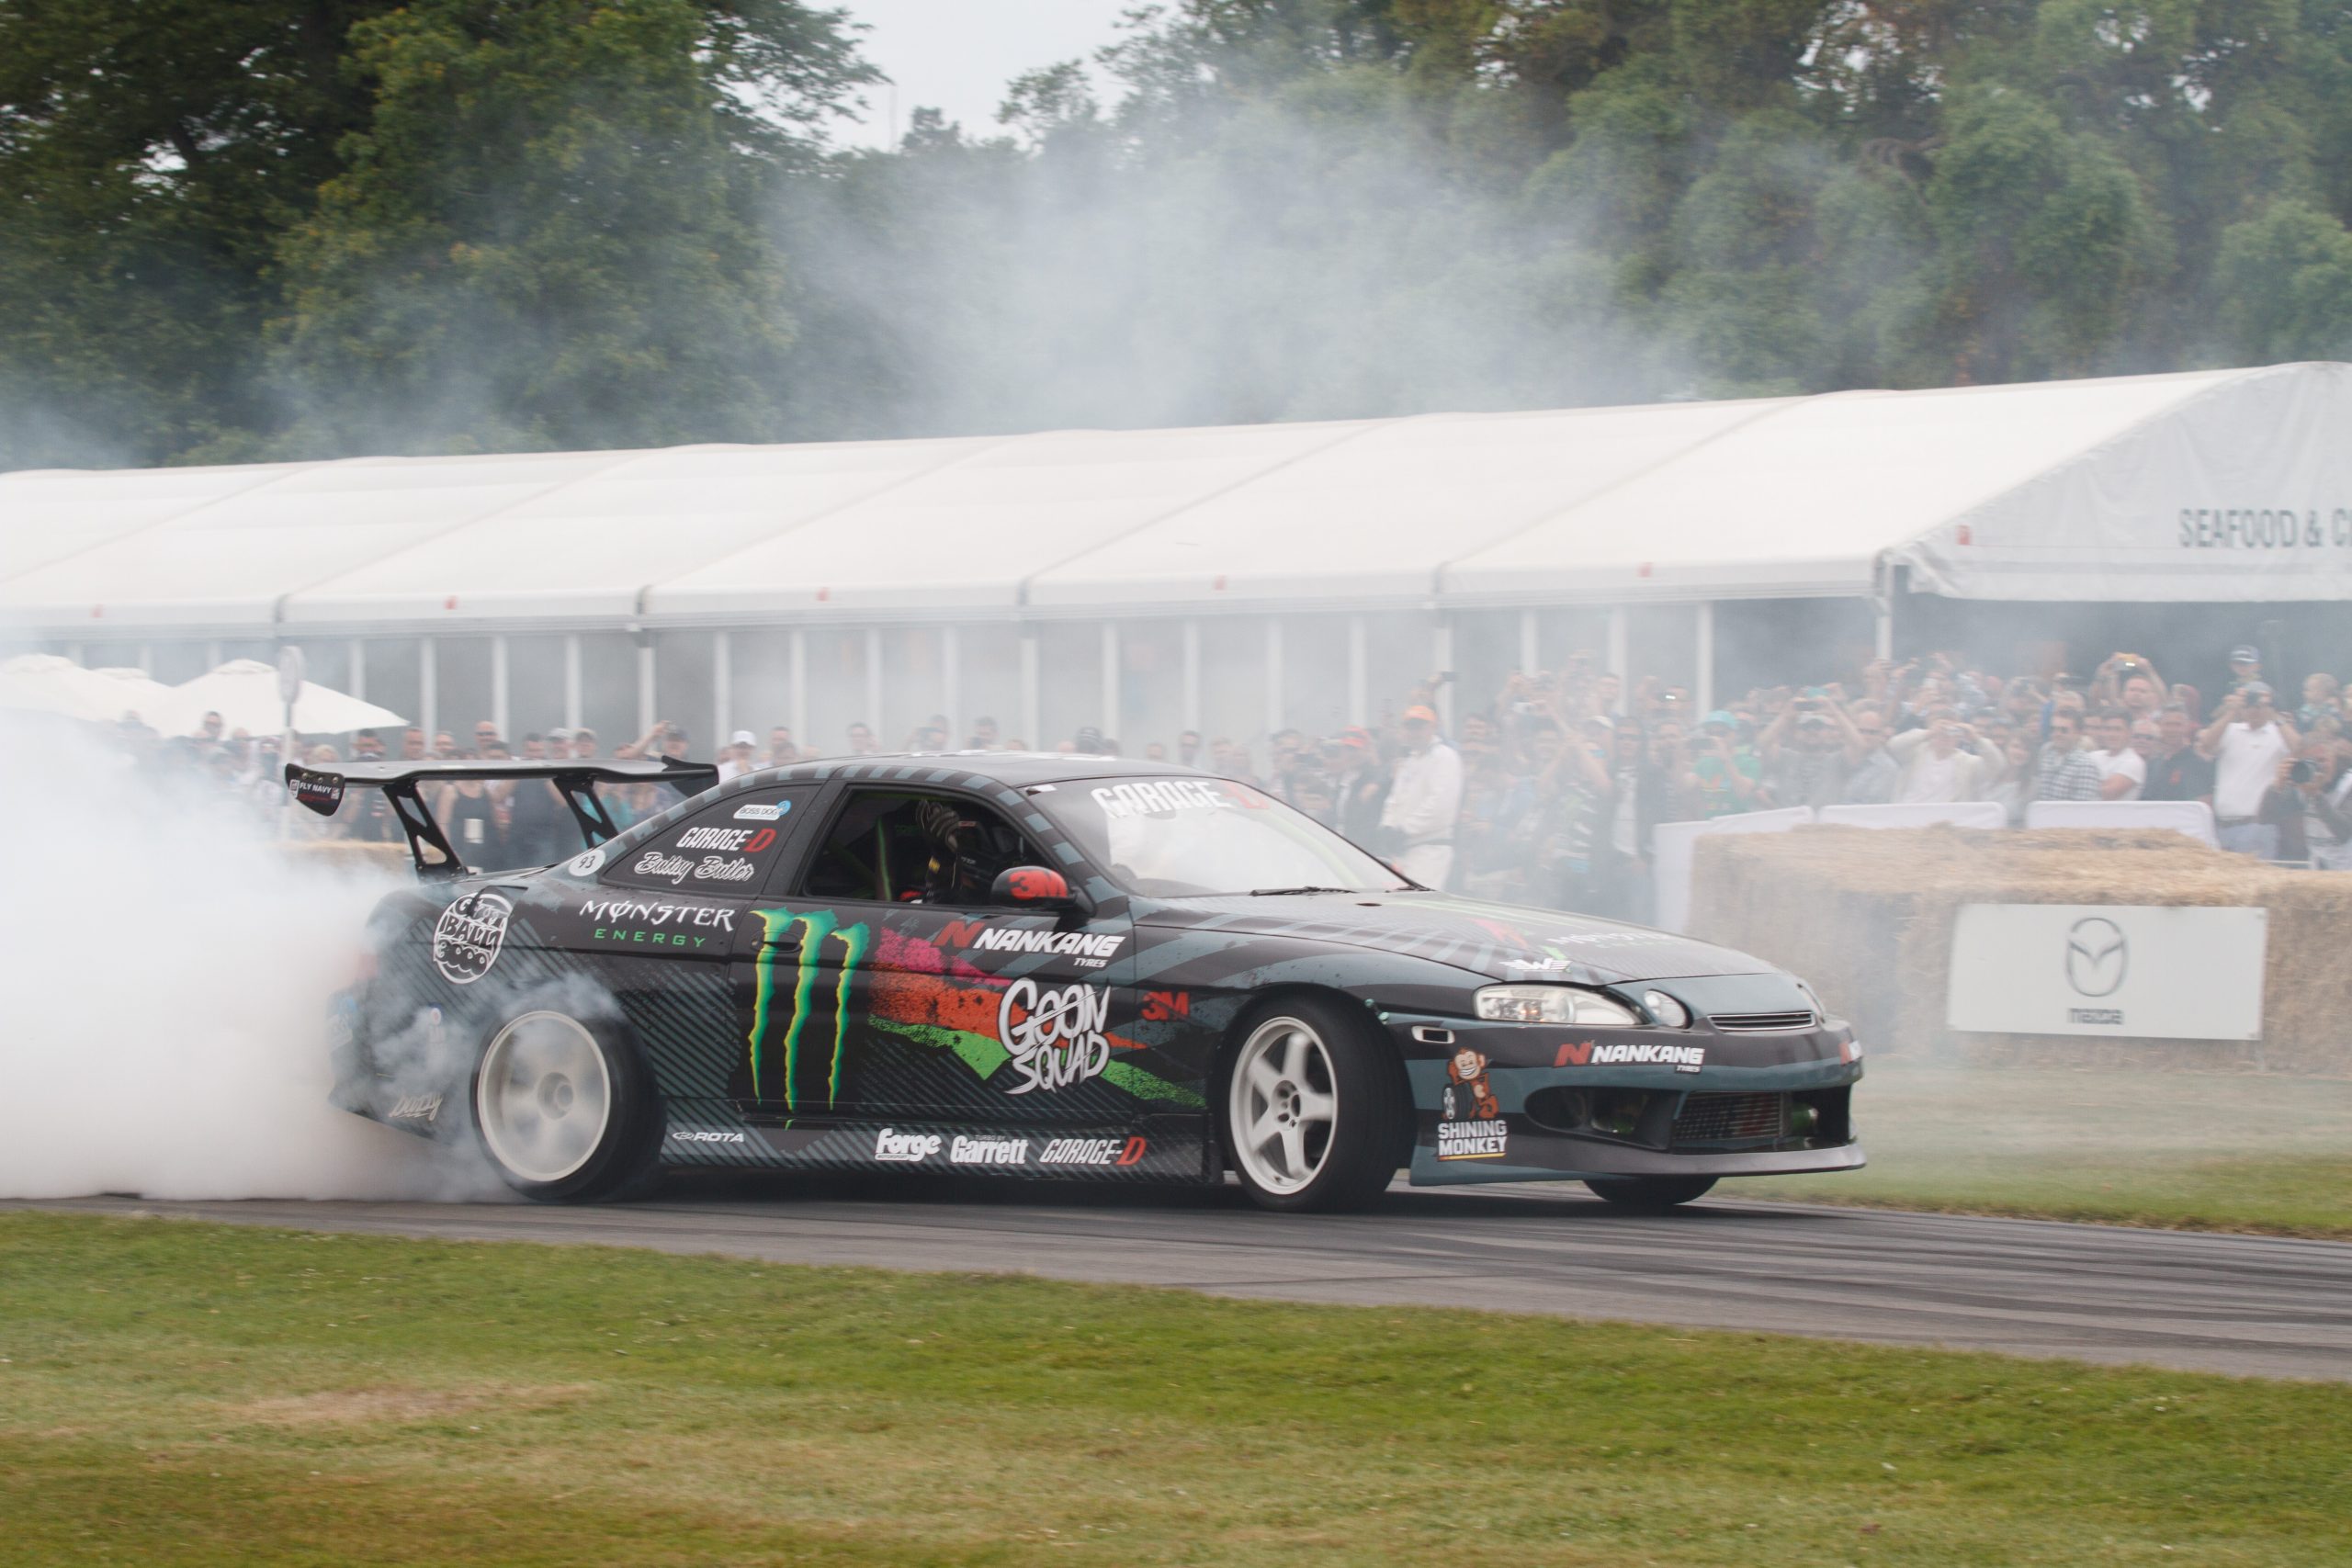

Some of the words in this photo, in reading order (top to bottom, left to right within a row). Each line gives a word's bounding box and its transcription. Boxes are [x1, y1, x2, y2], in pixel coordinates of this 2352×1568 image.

[2178, 509, 2296, 547] SEAFOOD
[2305, 510, 2323, 547] &
[299, 782, 312, 791] FLY
[312, 784, 332, 794] NAVY
[579, 855, 596, 869] 93
[1009, 869, 1069, 900] 3M
[594, 928, 706, 947] ENERGY
[973, 929, 1125, 957] NANKANG
[1073, 957, 1108, 967] TYRES
[999, 977, 1111, 1055] GOON
[1141, 991, 1189, 1021] 3M
[1004, 1030, 1110, 1094] SQUAD
[1590, 1045, 1705, 1064] NANKANG
[693, 1132, 744, 1142] ROTA
[1438, 1120, 1507, 1139] SHINING
[876, 1128, 942, 1162] Forge
[950, 1135, 1029, 1164] Garrett
[1439, 1136, 1507, 1156] MONKEY
